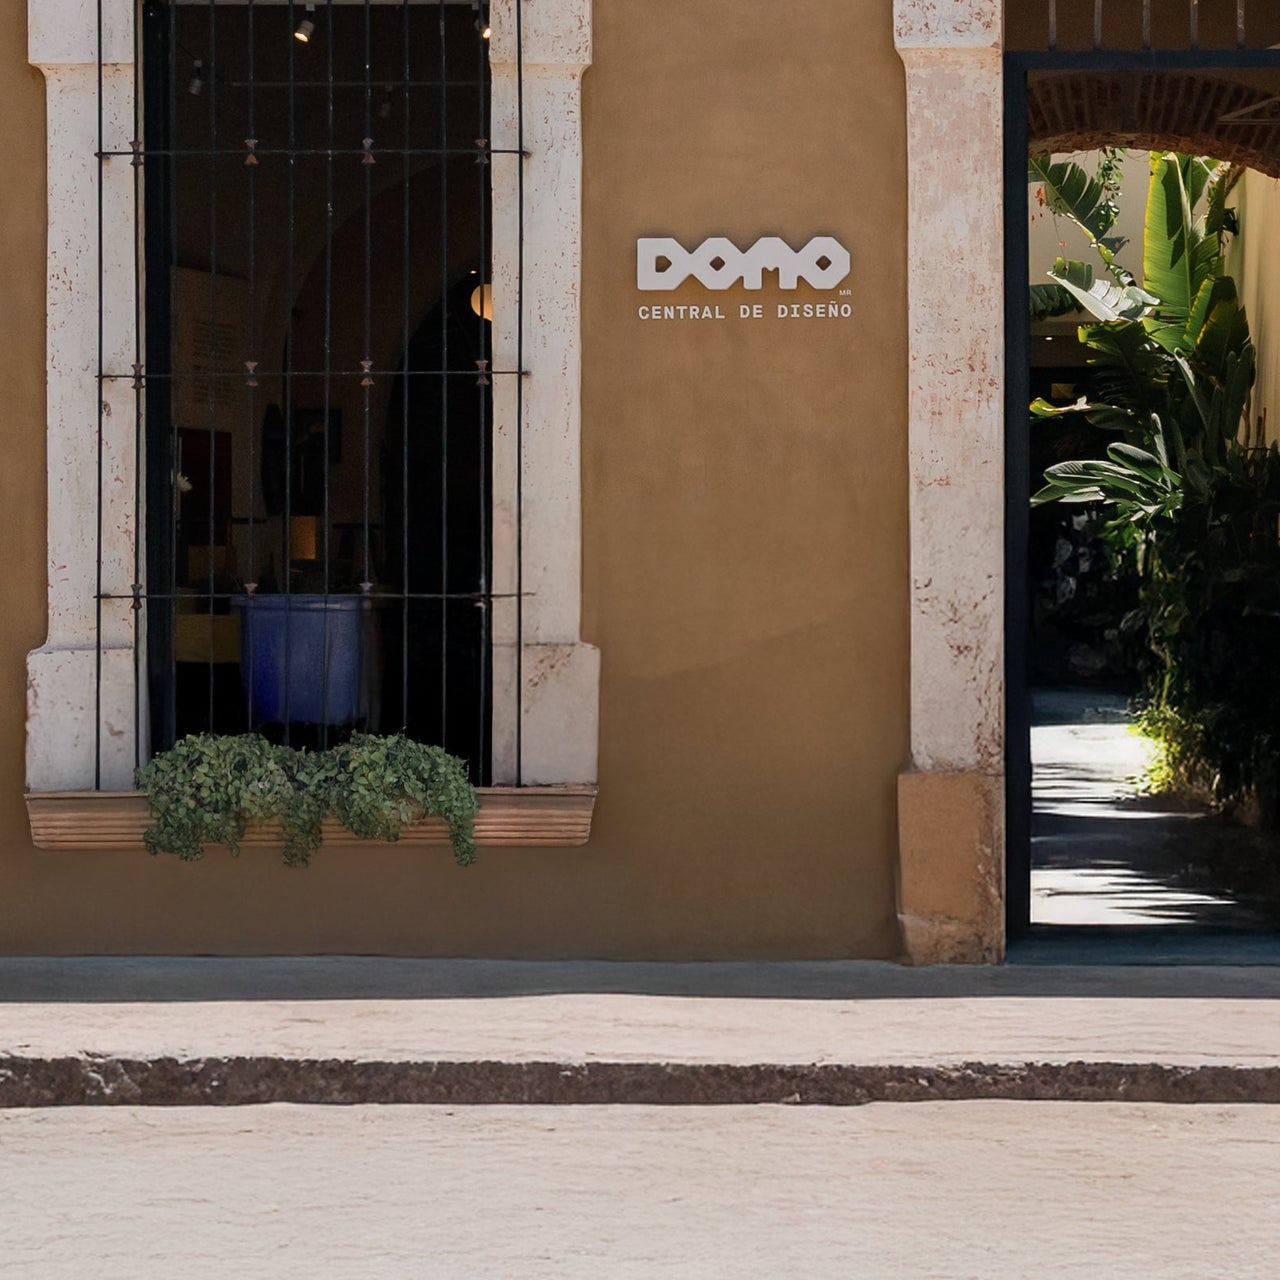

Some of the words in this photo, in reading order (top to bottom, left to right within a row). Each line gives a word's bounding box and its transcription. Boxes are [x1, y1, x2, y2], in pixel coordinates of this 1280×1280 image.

[636, 236, 851, 291] DOMO
[638, 305, 726, 320] CENTRAL
[739, 304, 763, 319] DE
[777, 300, 852, 318] DISEÑO
